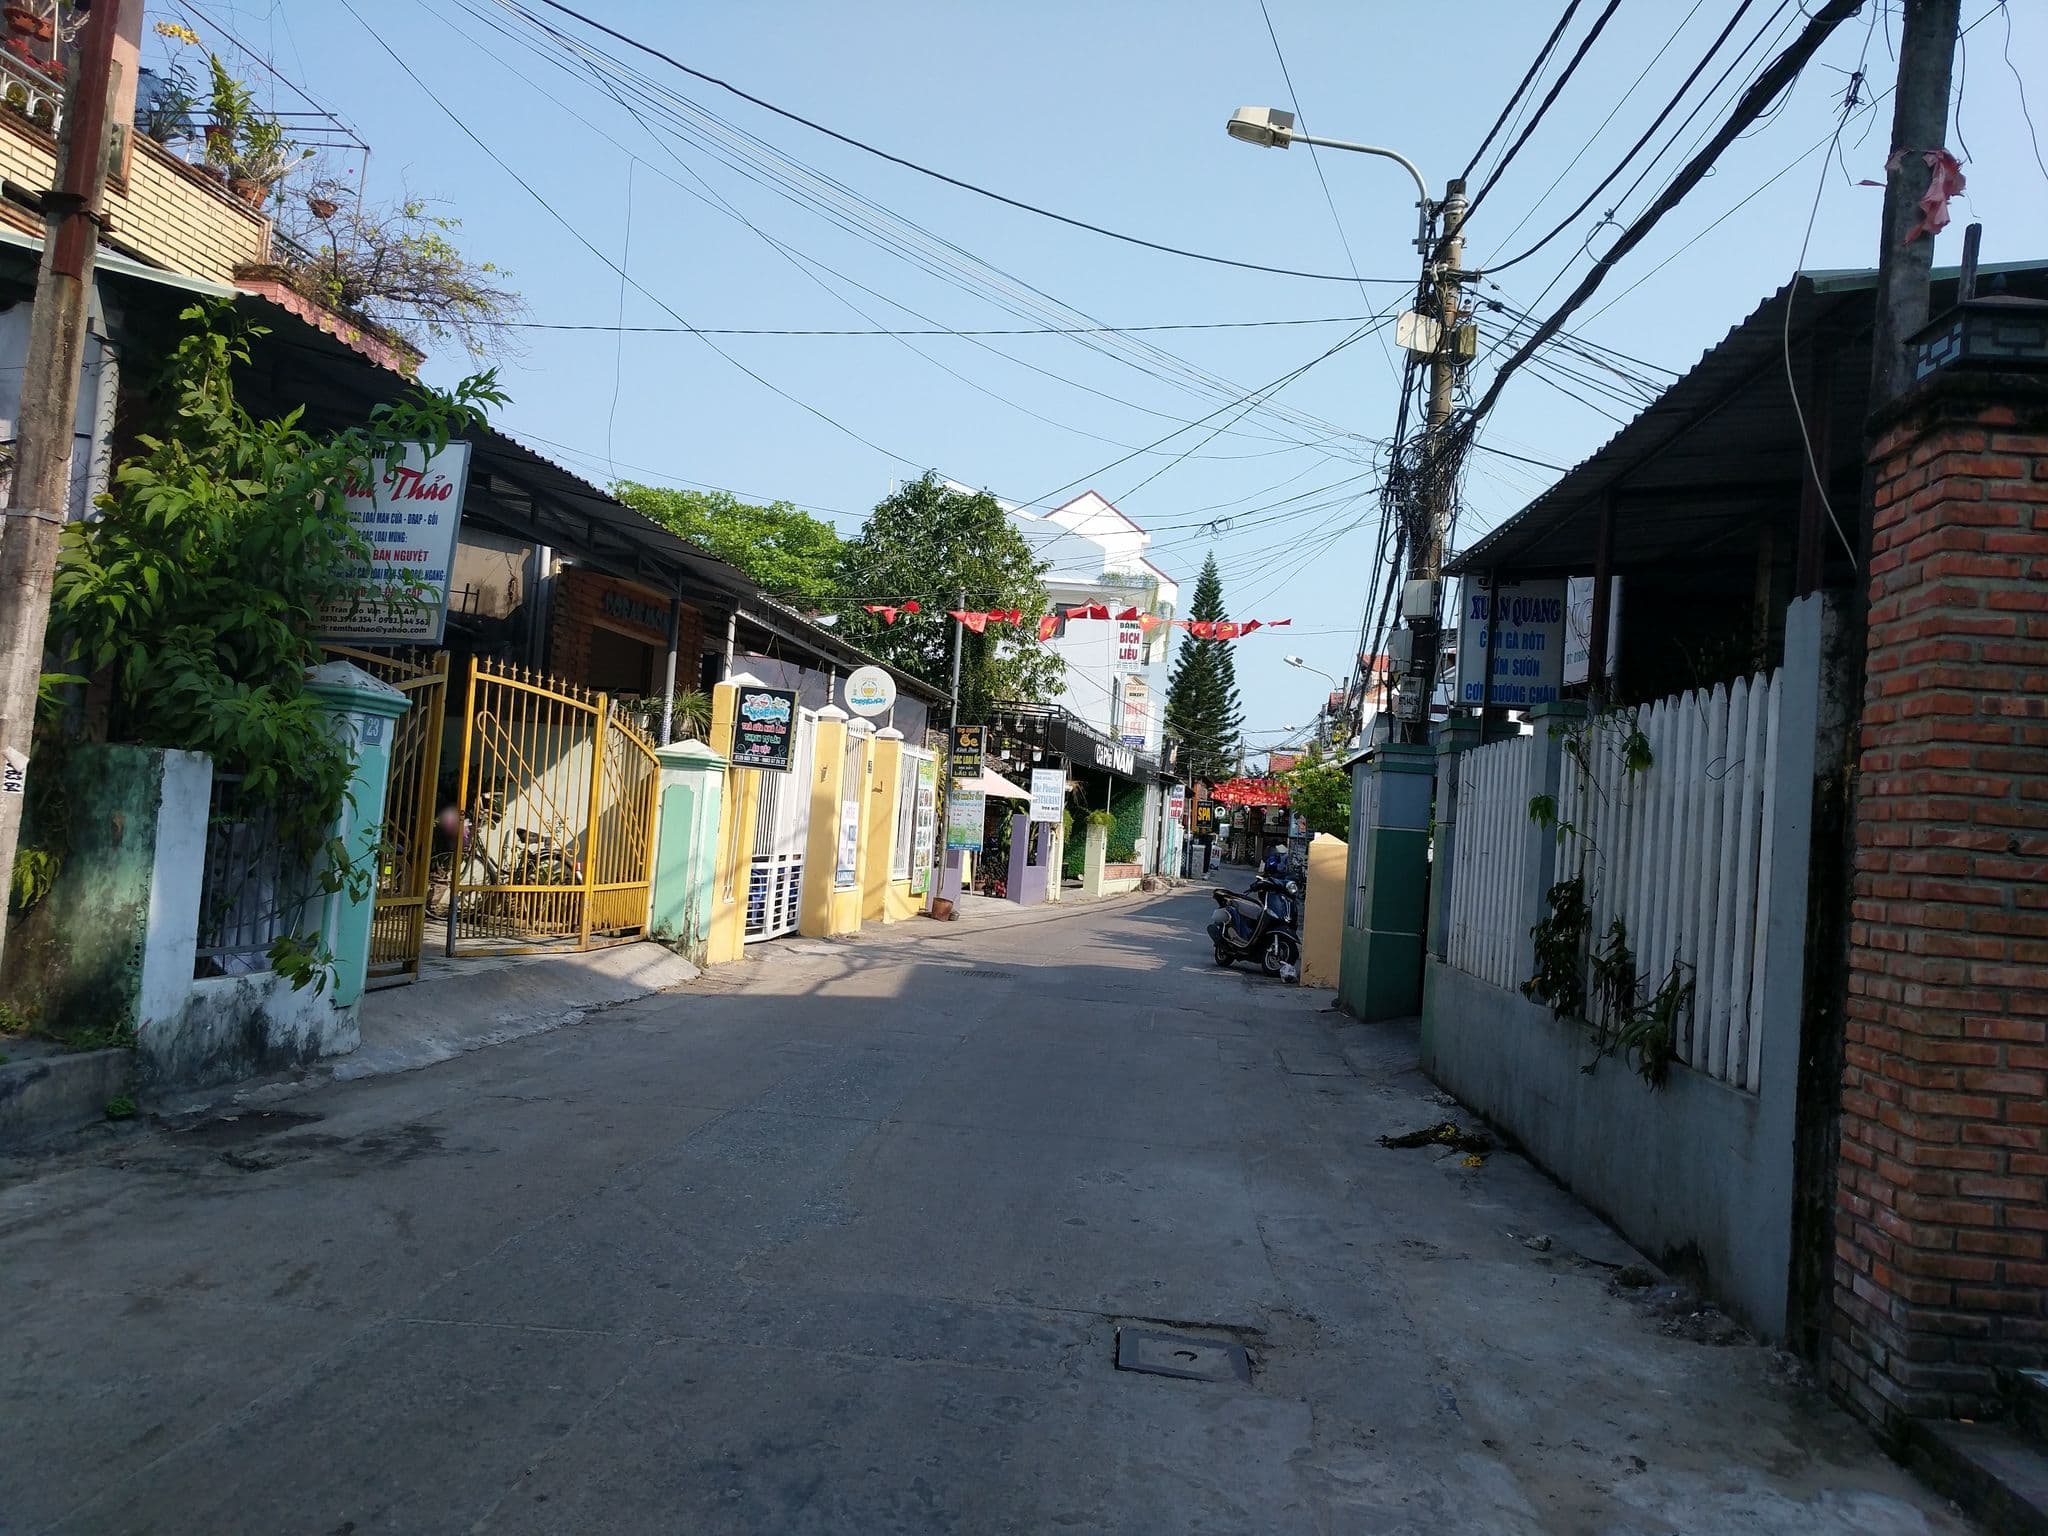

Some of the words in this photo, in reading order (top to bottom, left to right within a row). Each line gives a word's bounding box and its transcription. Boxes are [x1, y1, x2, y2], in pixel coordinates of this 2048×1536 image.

[383, 466, 453, 501] Thảo
[1512, 597, 1561, 627] QUANG
[366, 717, 379, 737] 23
[1113, 747, 1134, 775] NAM
[1198, 807, 1211, 822] SPA
